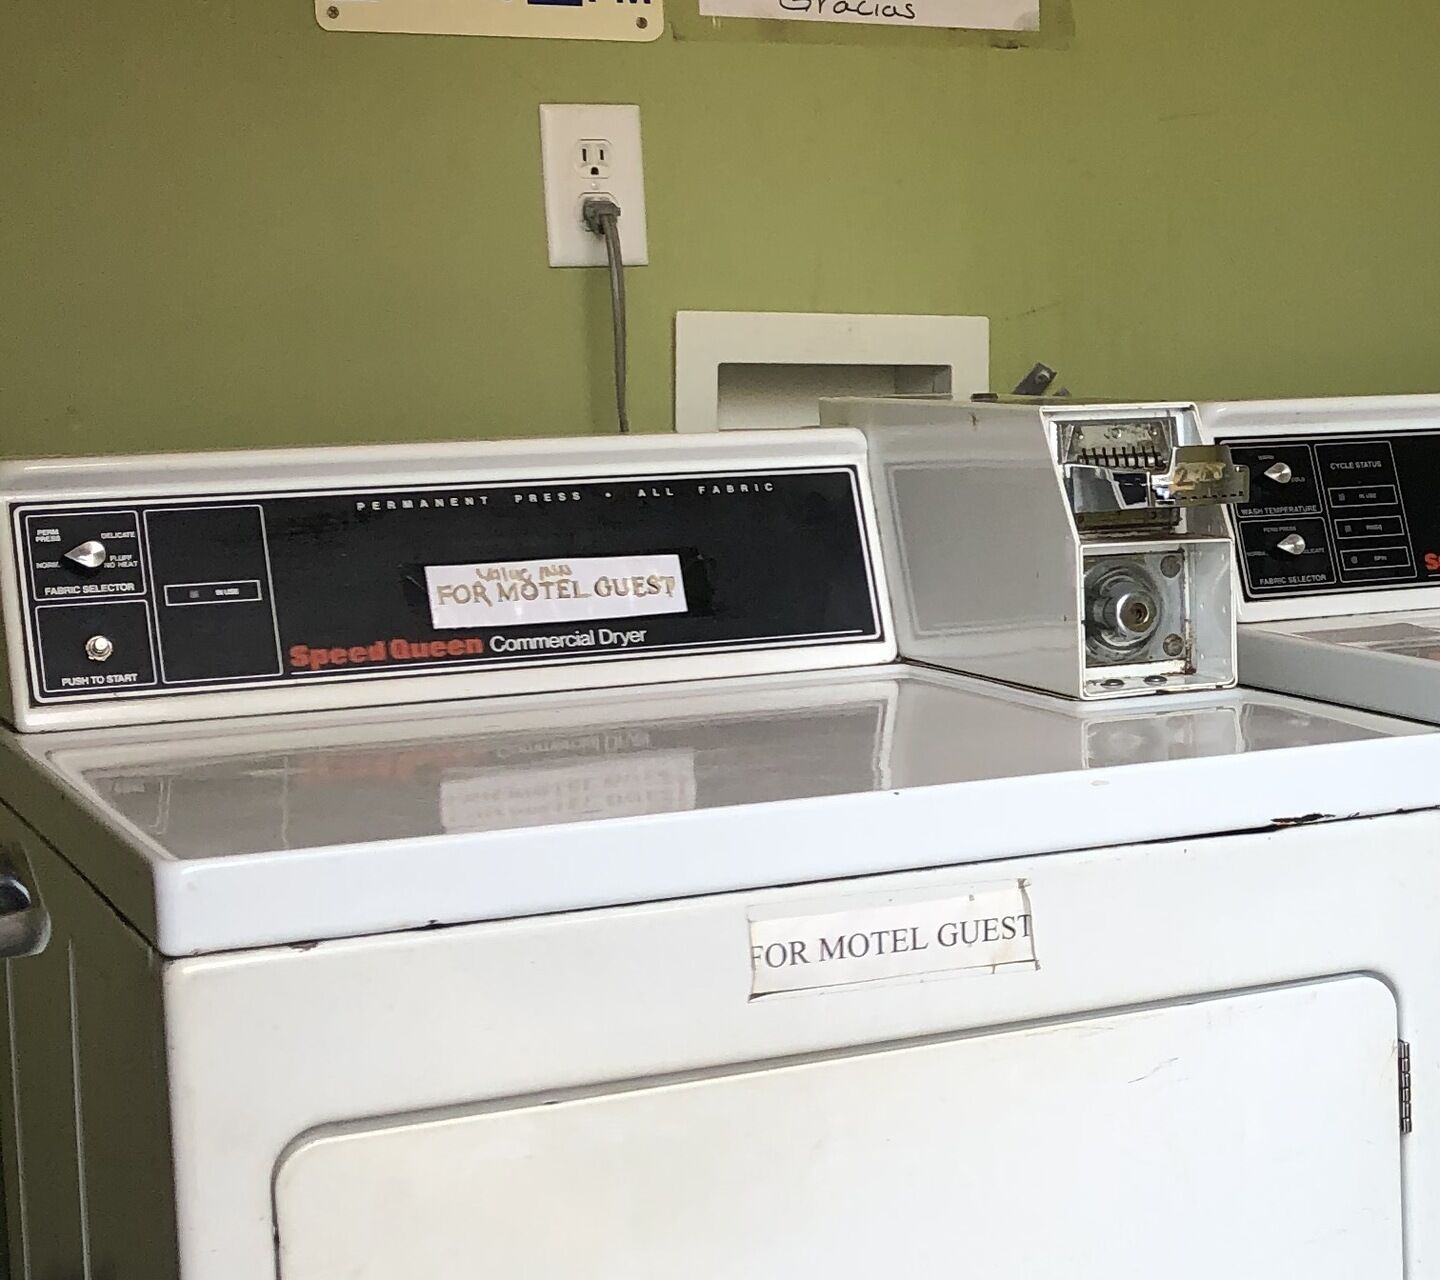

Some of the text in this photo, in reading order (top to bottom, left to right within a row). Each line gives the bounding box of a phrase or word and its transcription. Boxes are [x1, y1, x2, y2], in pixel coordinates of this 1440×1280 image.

[1330, 460, 1382, 470] CYCLE STATUS
[356, 482, 774, 511] PERMANENT PRESS ALL FABRIC
[1264, 505, 1317, 515] TEMPERATURE
[1260, 574, 1327, 586] FABRIC SELECTOR
[44, 583, 135, 596] FABRIC SELECTOR
[436, 575, 676, 607] FOR MOTEL GUEST
[289, 628, 648, 669] Speed Queen Commercial Dryer
[61, 673, 138, 686] PUSH TO START
[819, 926, 929, 962] MOTEL
[937, 914, 1031, 947] GUEST
